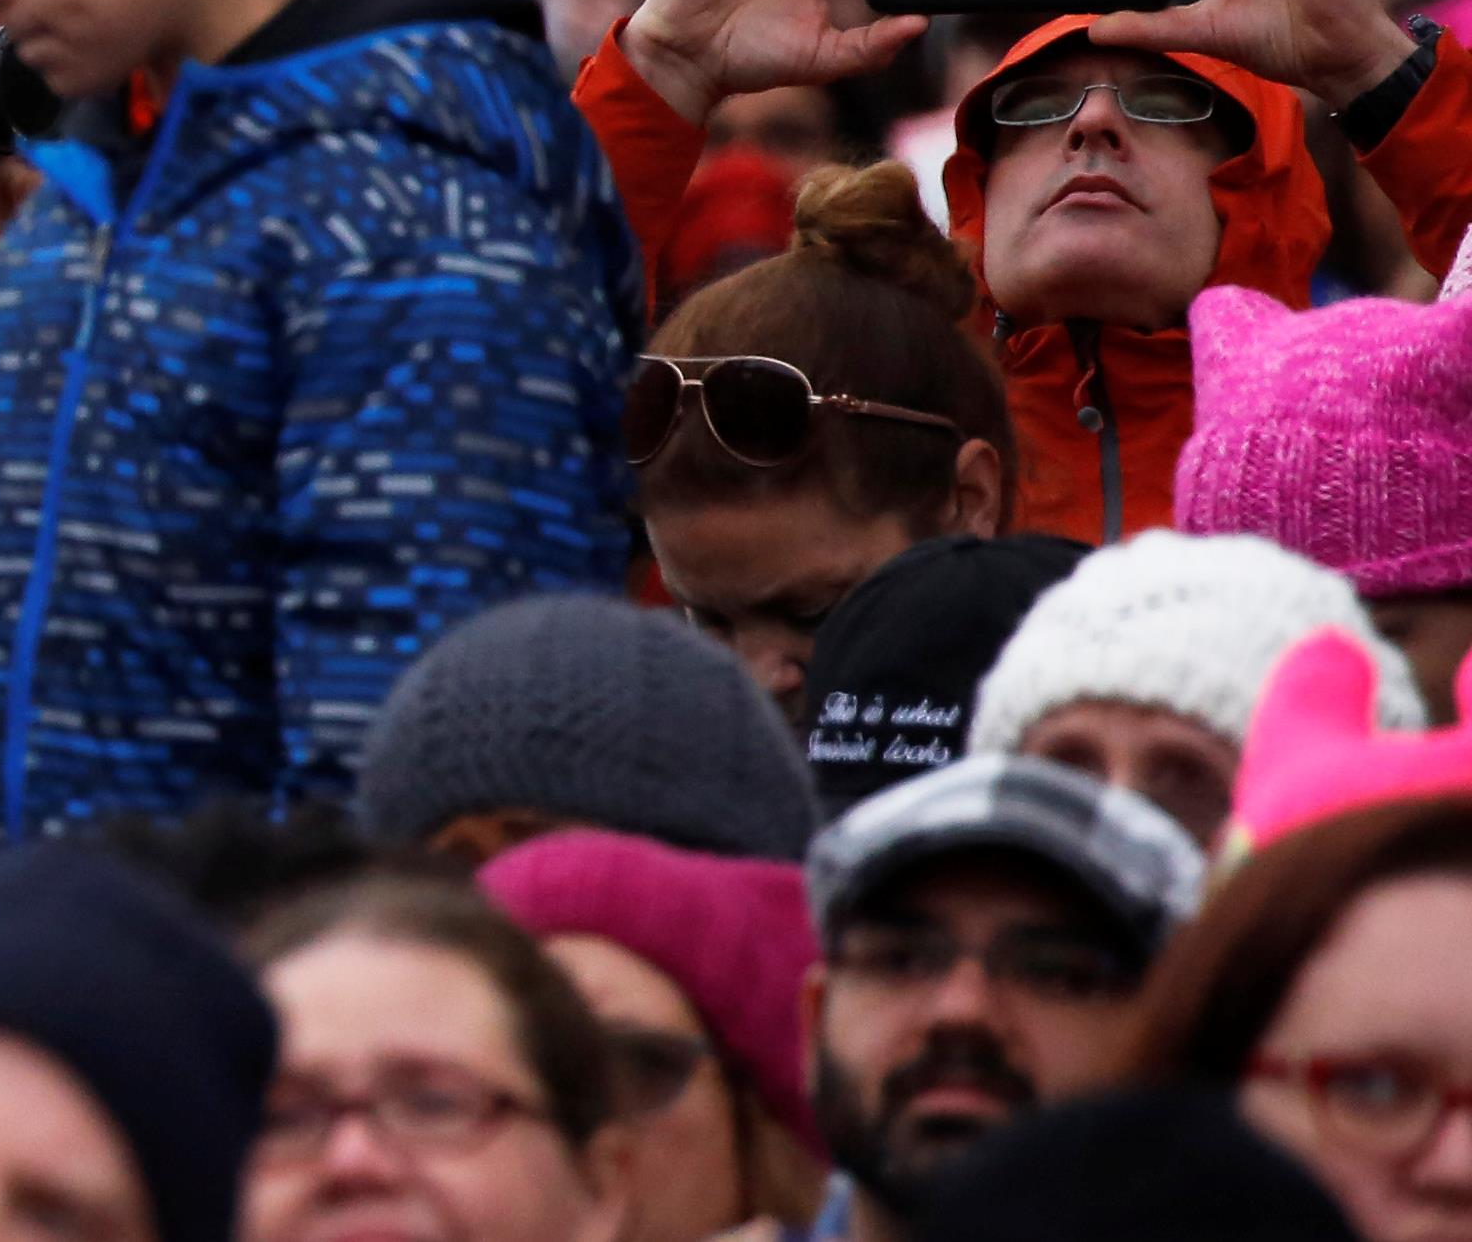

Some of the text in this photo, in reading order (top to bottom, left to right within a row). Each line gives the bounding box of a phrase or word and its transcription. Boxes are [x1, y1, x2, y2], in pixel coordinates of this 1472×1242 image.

[818, 690, 961, 727] This is what
[883, 732, 951, 764] looks
